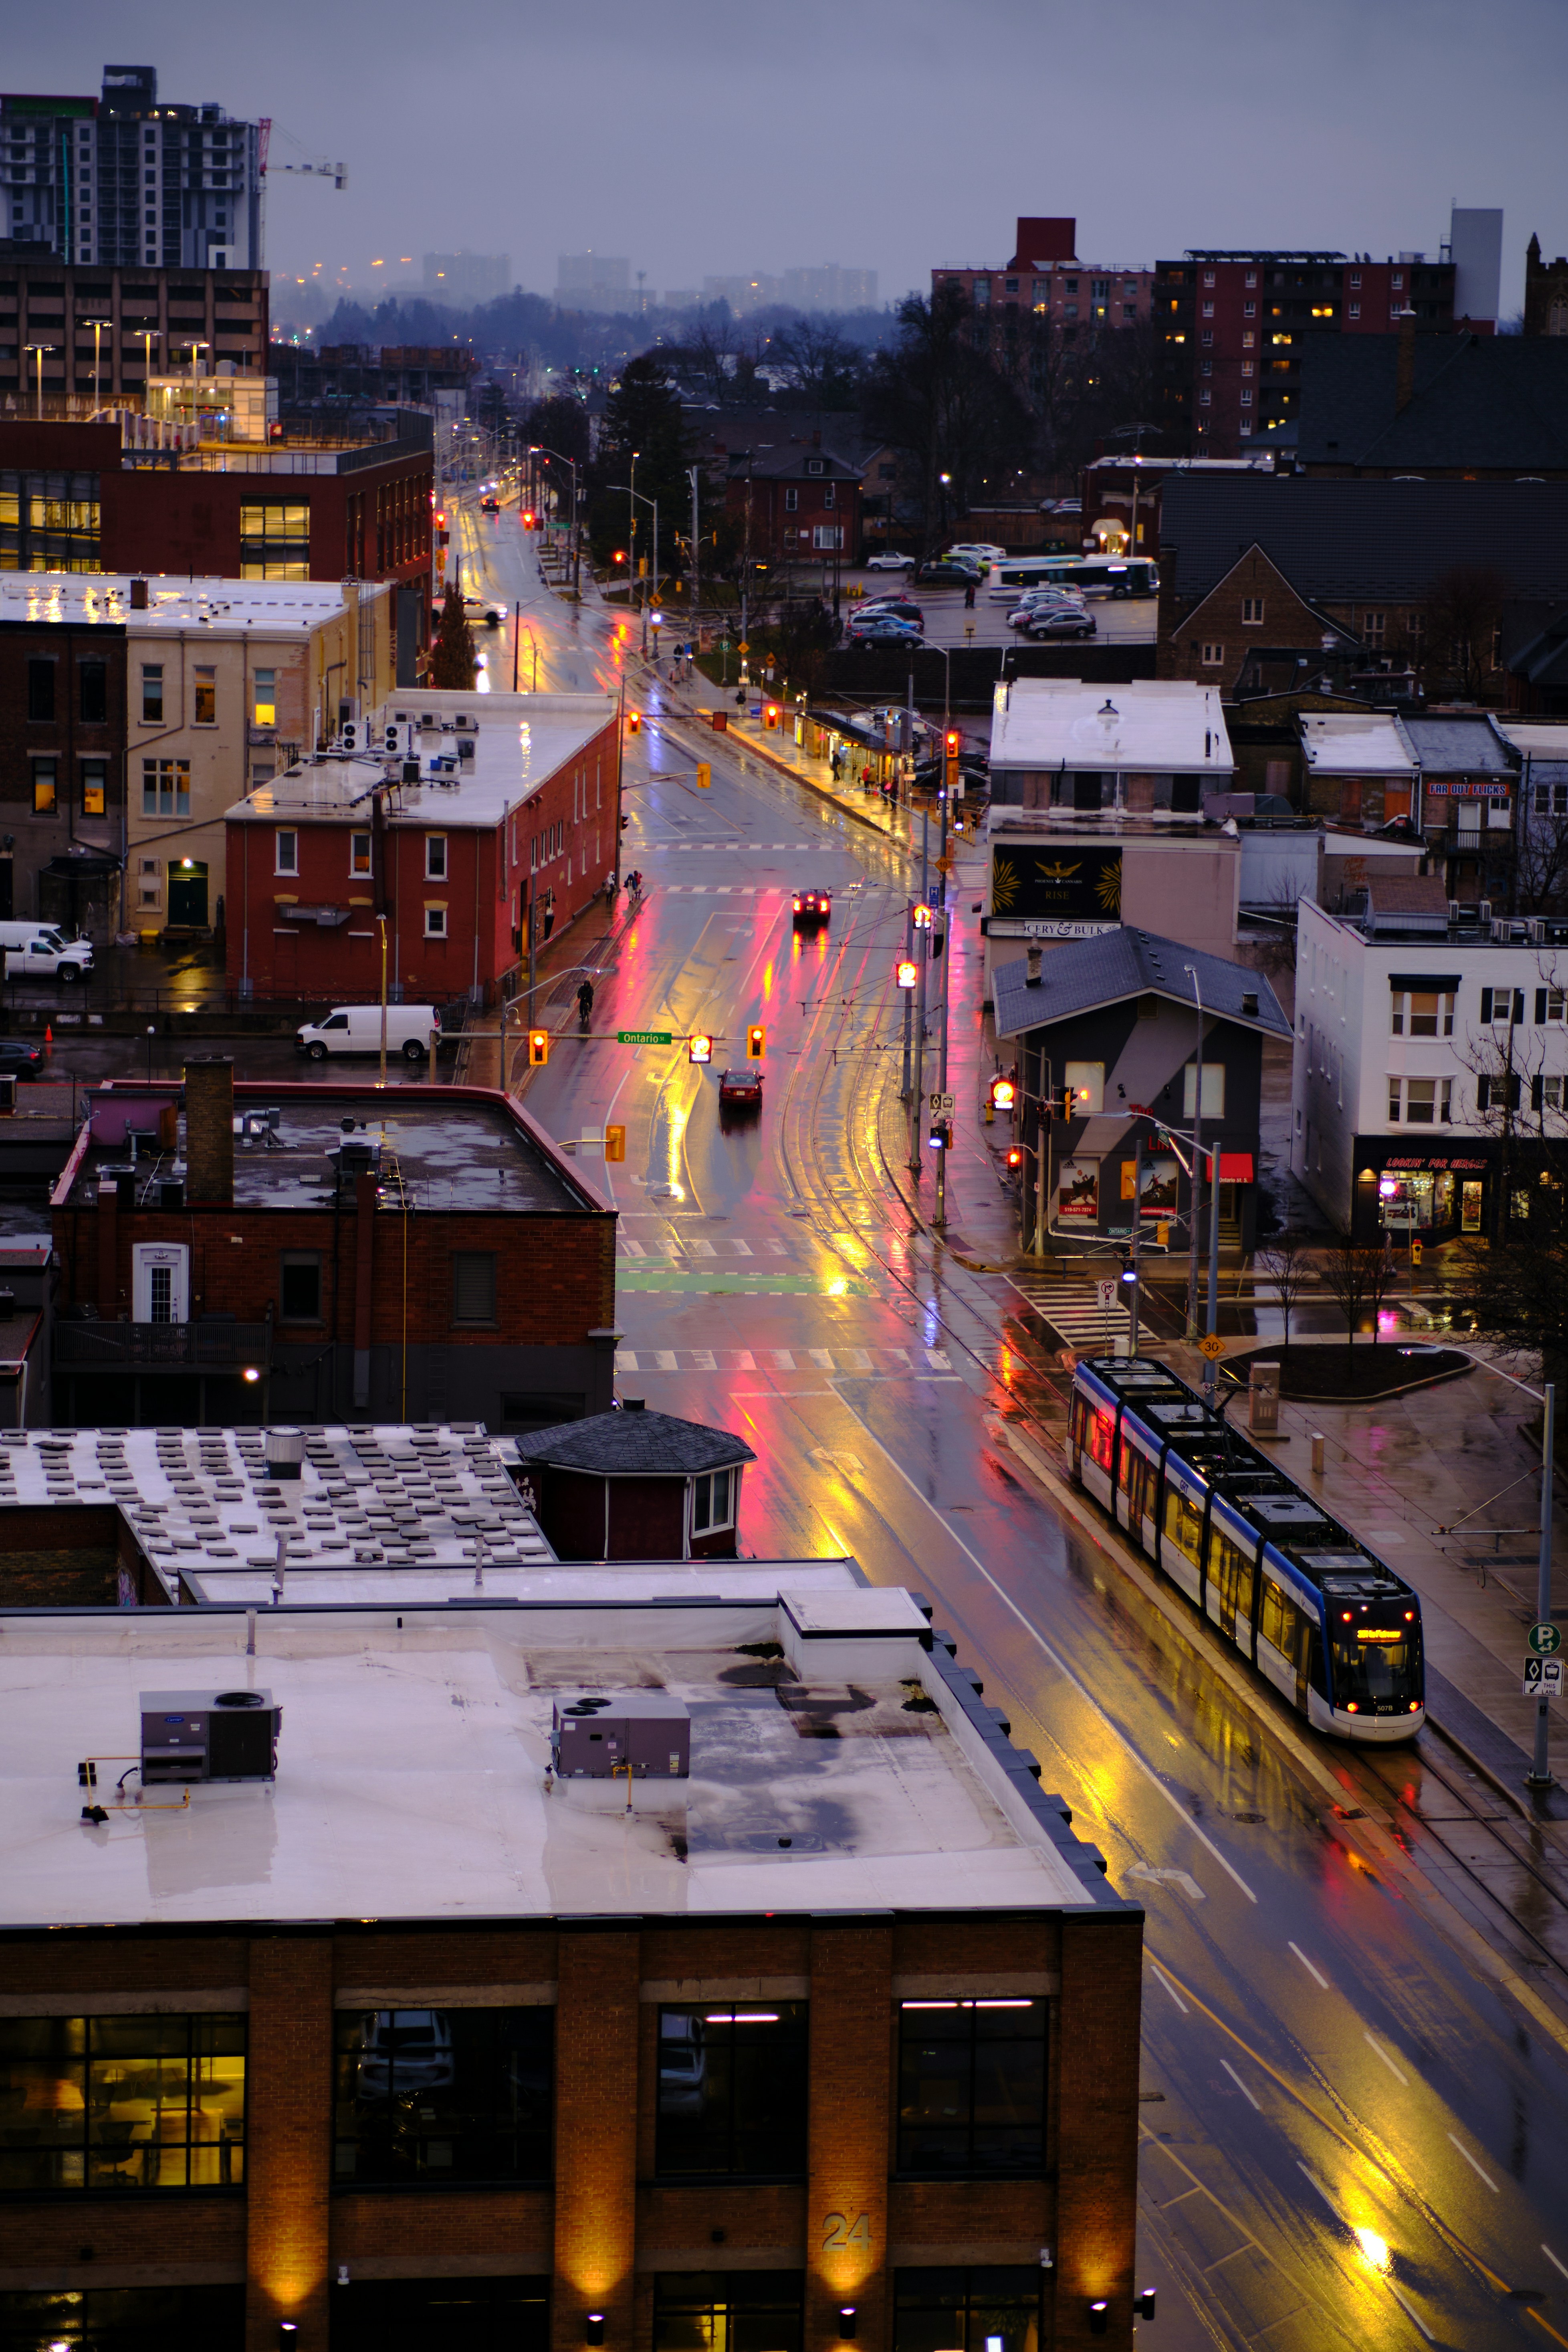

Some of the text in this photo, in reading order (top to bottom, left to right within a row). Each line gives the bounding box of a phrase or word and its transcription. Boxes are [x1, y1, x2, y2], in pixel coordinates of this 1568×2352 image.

[1429, 783, 1506, 795] FAR OUT FLICKS
[930, 888, 938, 896] H
[1045, 891, 1069, 900] RISE
[1074, 926, 1104, 935] BULK
[624, 1034, 659, 1043] Ontario
[1130, 1104, 1154, 1119] The
[1386, 1158, 1487, 1169] LOOKIN' FOR HEROES
[1205, 1342, 1219, 1351] 30
[1180, 1480, 1189, 1494] GRT
[1538, 1626, 1554, 1645] P
[822, 2212, 872, 2251] 24
